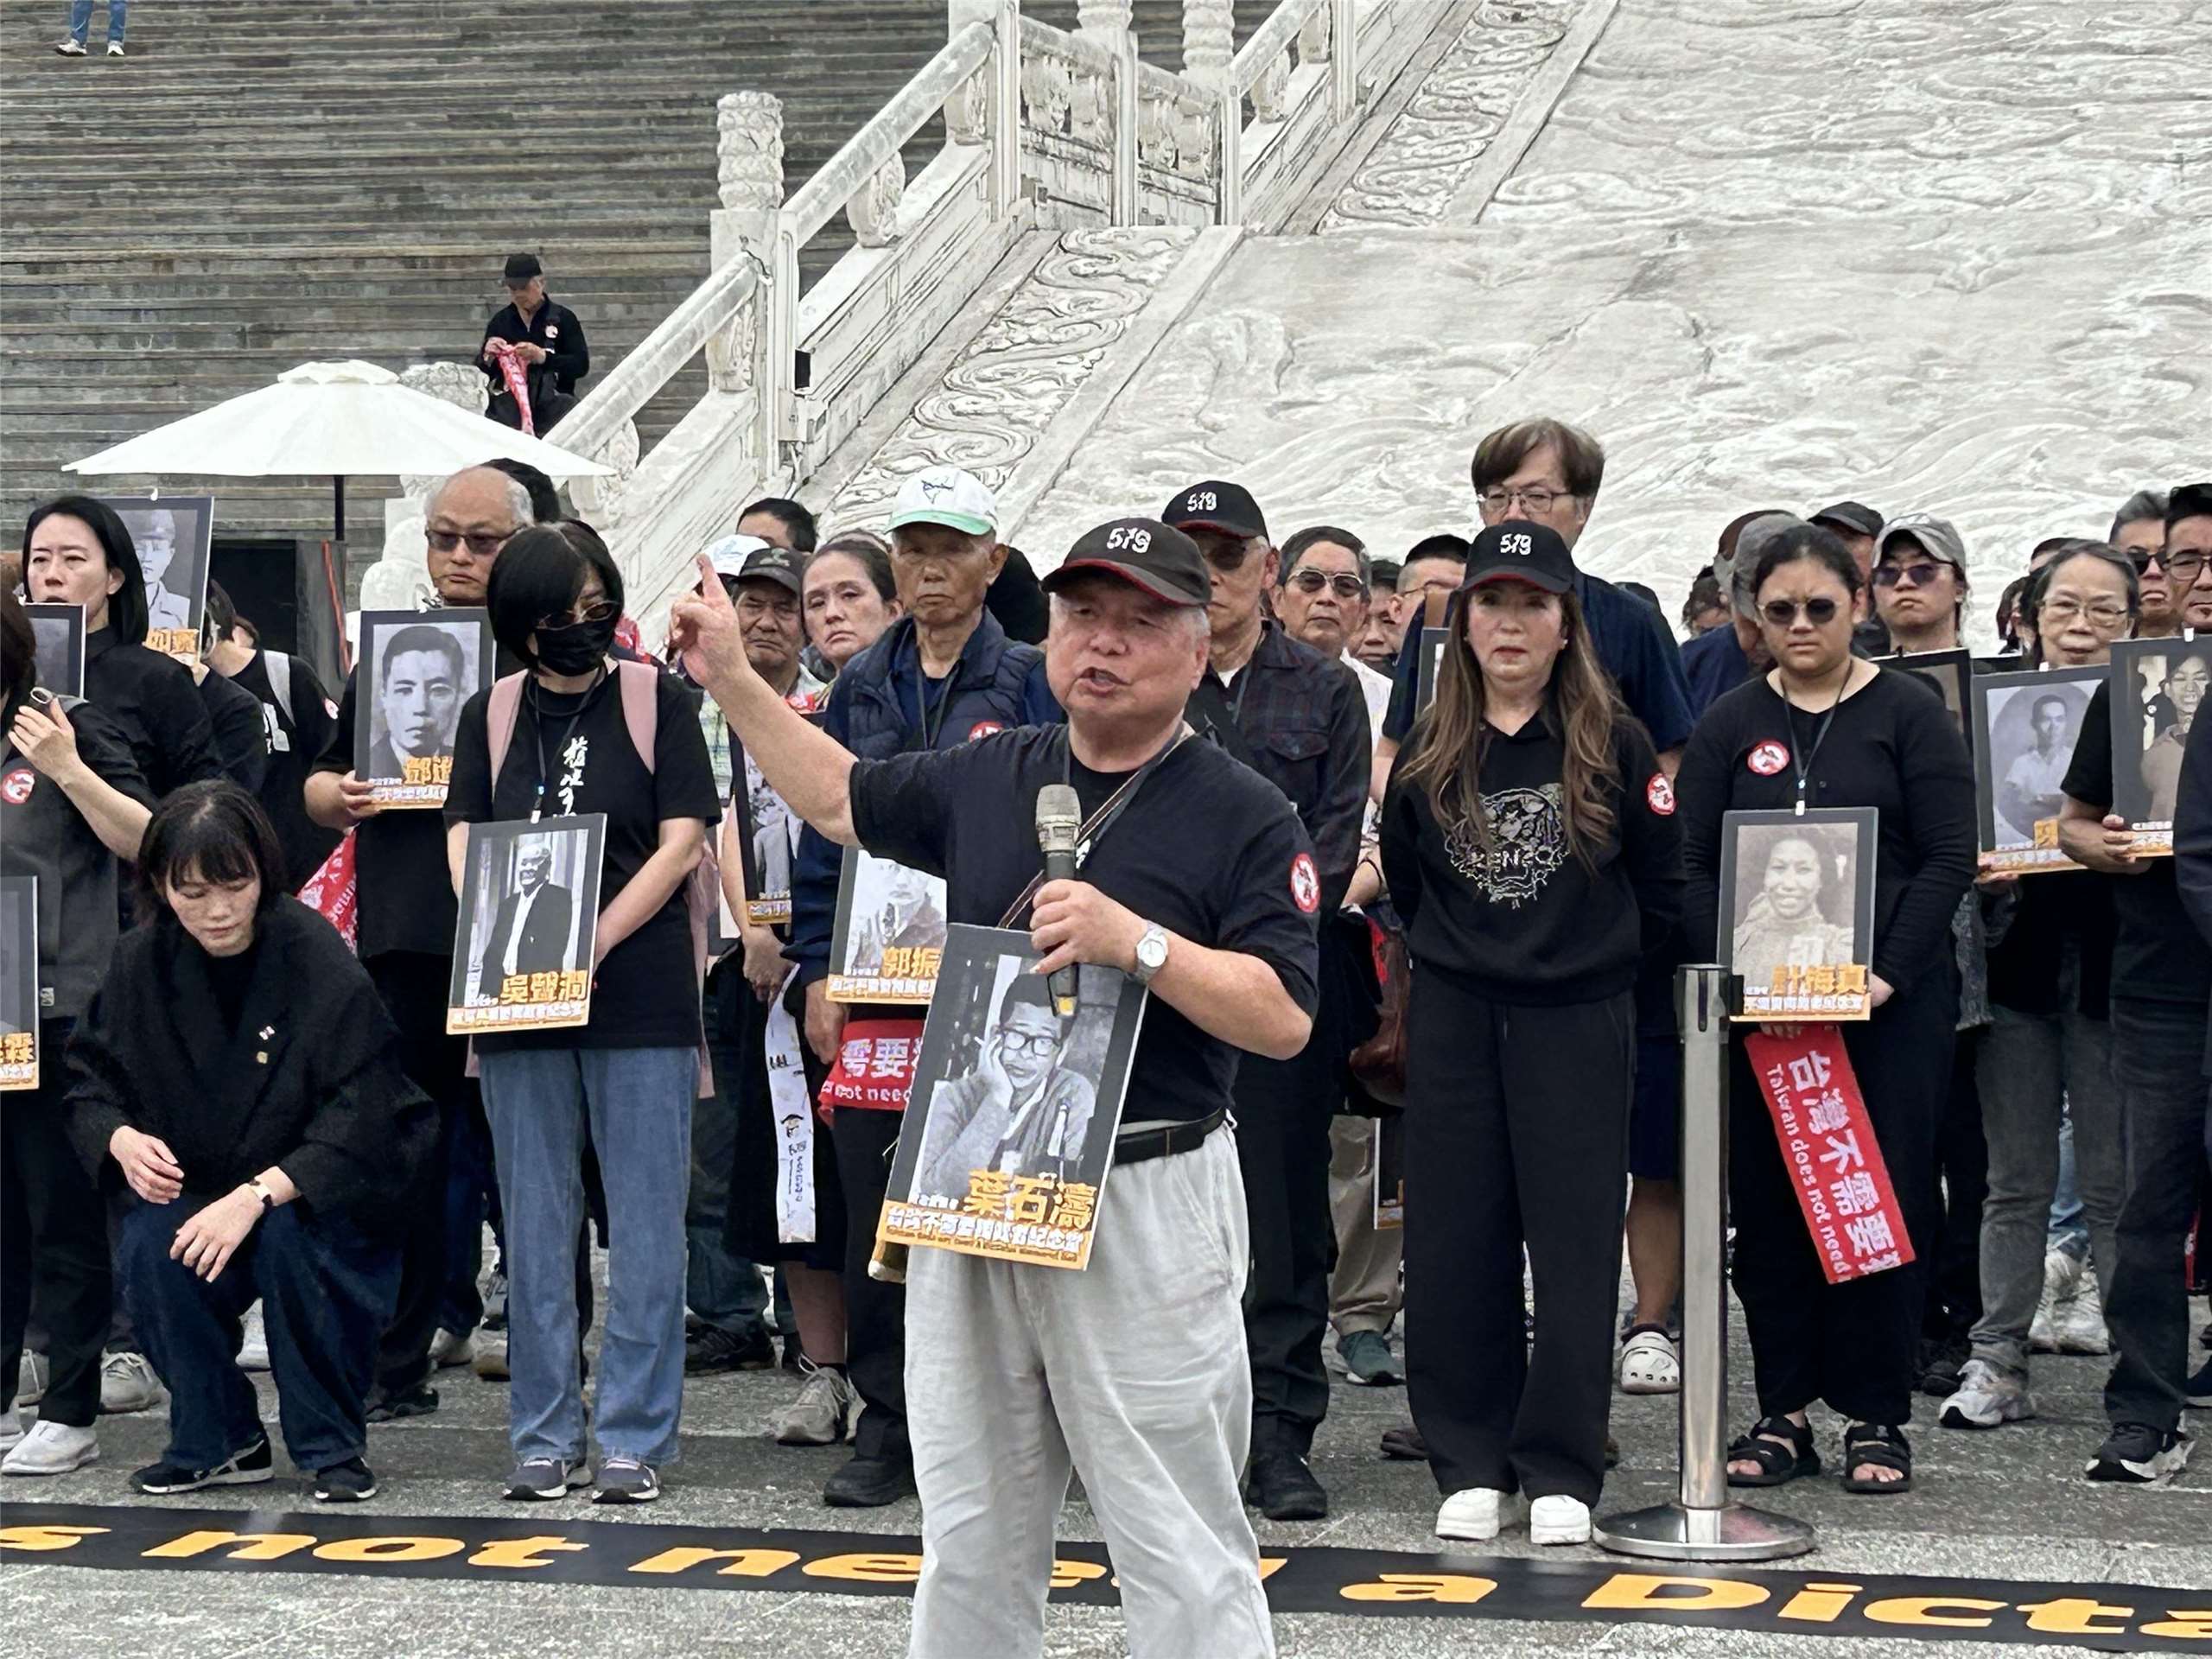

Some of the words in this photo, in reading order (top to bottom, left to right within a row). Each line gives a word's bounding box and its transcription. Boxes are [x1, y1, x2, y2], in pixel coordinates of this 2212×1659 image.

[841, 1037, 923, 1078] 需要
[1766, 1062, 1801, 1137] Taiwan
[1789, 1138, 1817, 1188] does
[963, 1168, 1097, 1230] 葉石濤
[1806, 1189, 1833, 1224] not
[1819, 1224, 1853, 1274] need
[140, 1530, 591, 1568] not
[626, 1547, 1288, 1588] ne
[1339, 1573, 1499, 1603] a
